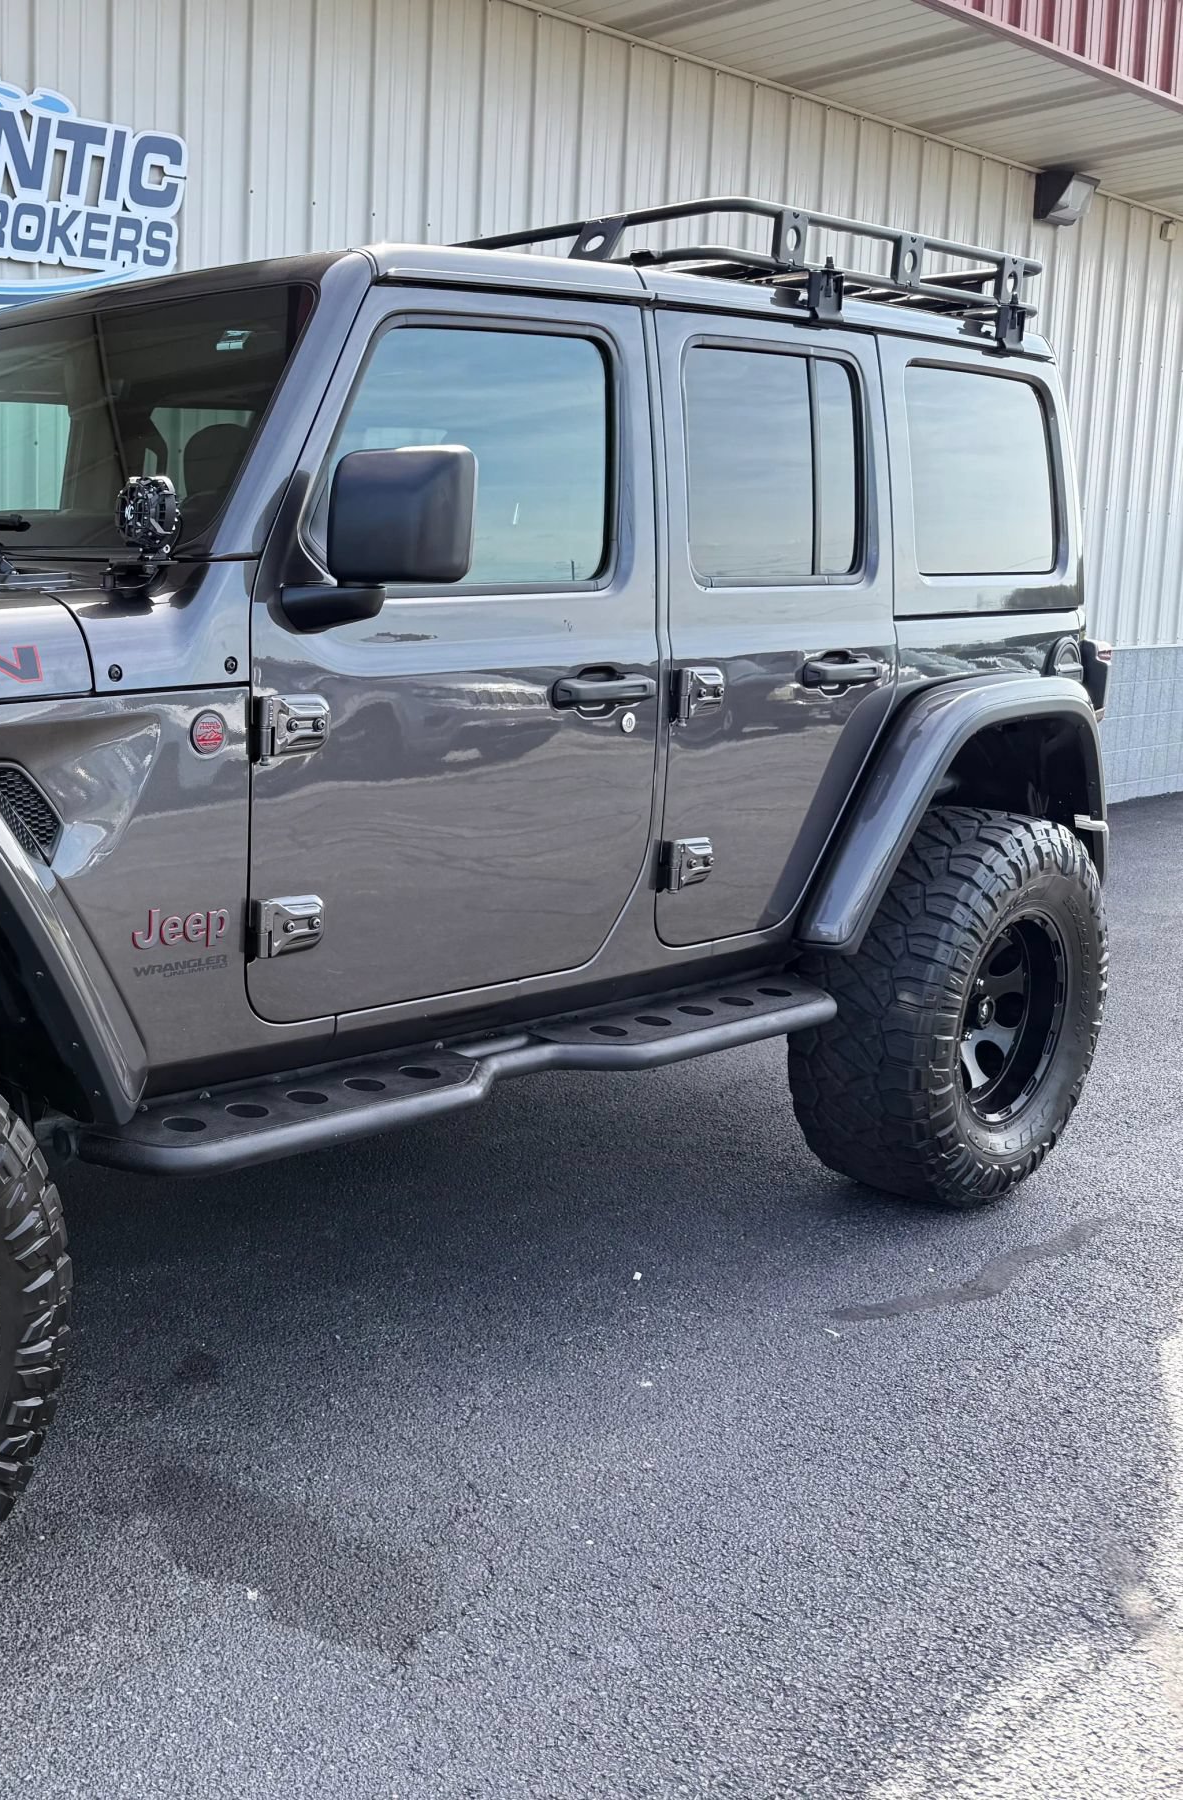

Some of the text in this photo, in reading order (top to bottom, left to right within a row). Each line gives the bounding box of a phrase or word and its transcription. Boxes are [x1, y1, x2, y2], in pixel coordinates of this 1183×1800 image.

[131, 907, 231, 951] Jeep
[133, 954, 228, 977] WRANGLER
[163, 962, 229, 979] UNLIMITED
